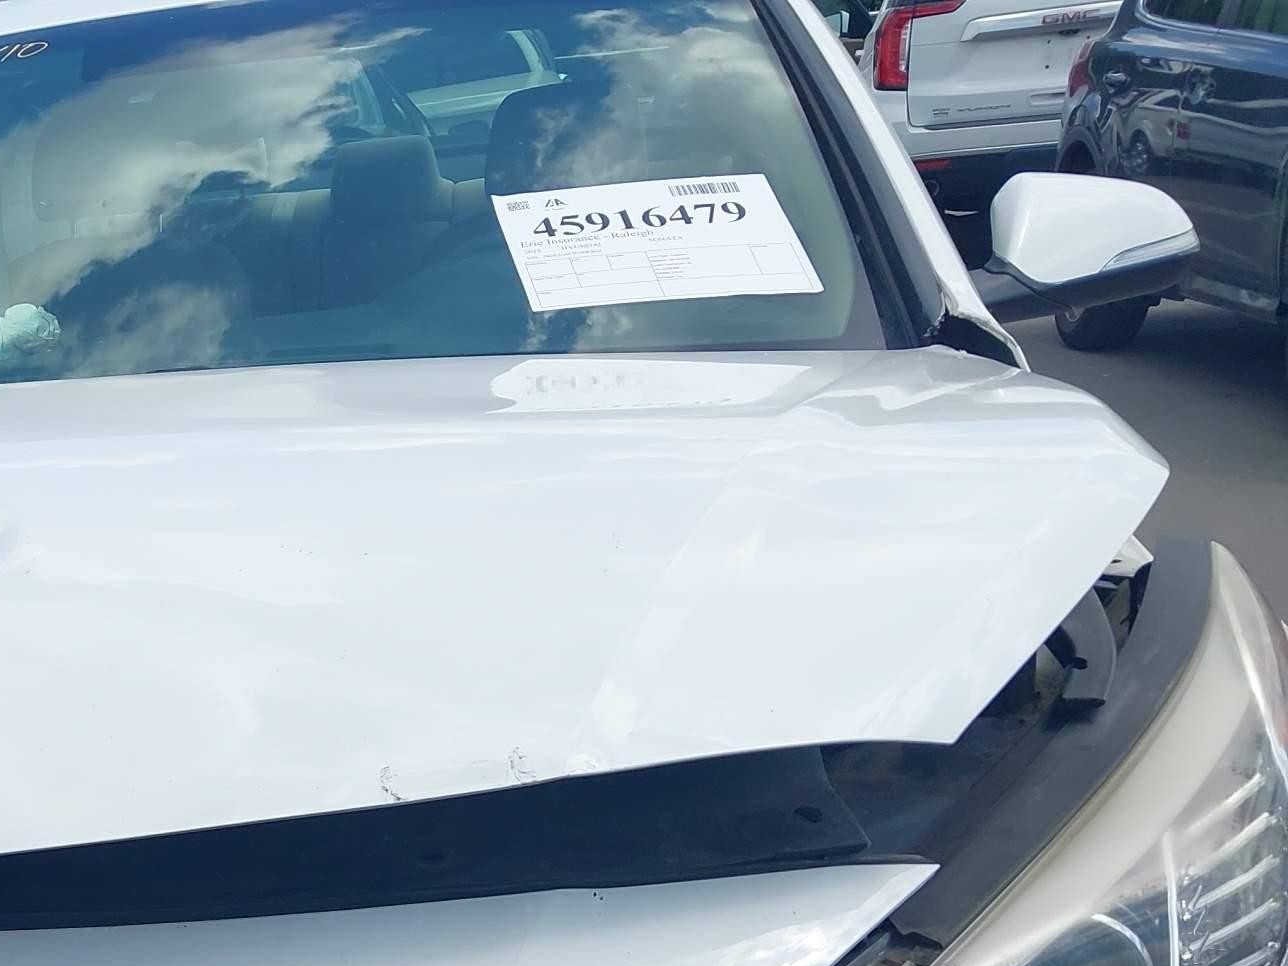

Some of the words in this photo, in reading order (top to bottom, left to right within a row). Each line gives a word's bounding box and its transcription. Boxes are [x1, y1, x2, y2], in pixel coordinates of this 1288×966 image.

[1041, 9, 1101, 25] GMC
[533, 201, 746, 238] 45916479
[520, 240, 544, 249] Erie
[546, 233, 601, 246] Insurance
[611, 228, 654, 240] Raleigh
